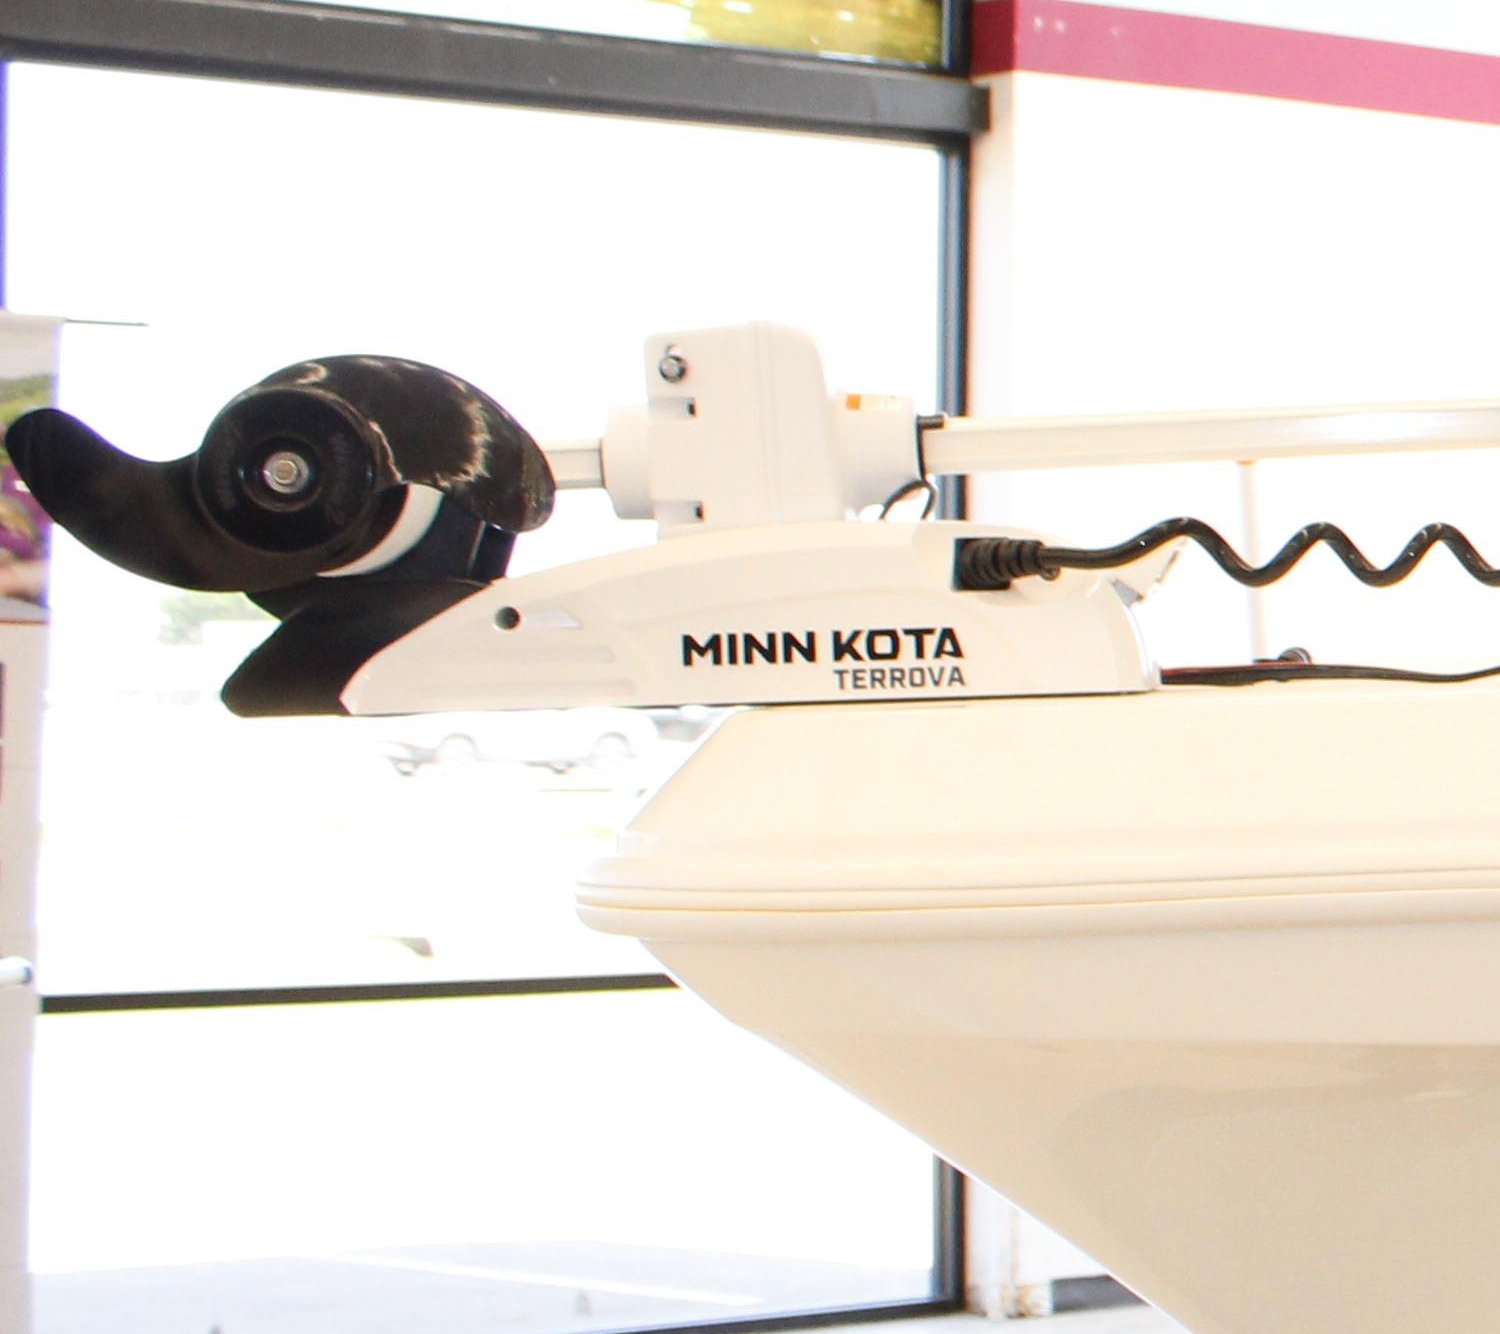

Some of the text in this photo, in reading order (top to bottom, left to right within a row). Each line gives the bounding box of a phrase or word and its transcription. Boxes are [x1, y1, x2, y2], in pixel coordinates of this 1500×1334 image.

[682, 627, 965, 666] MINN KOTA
[833, 667, 966, 691] TERROVA
